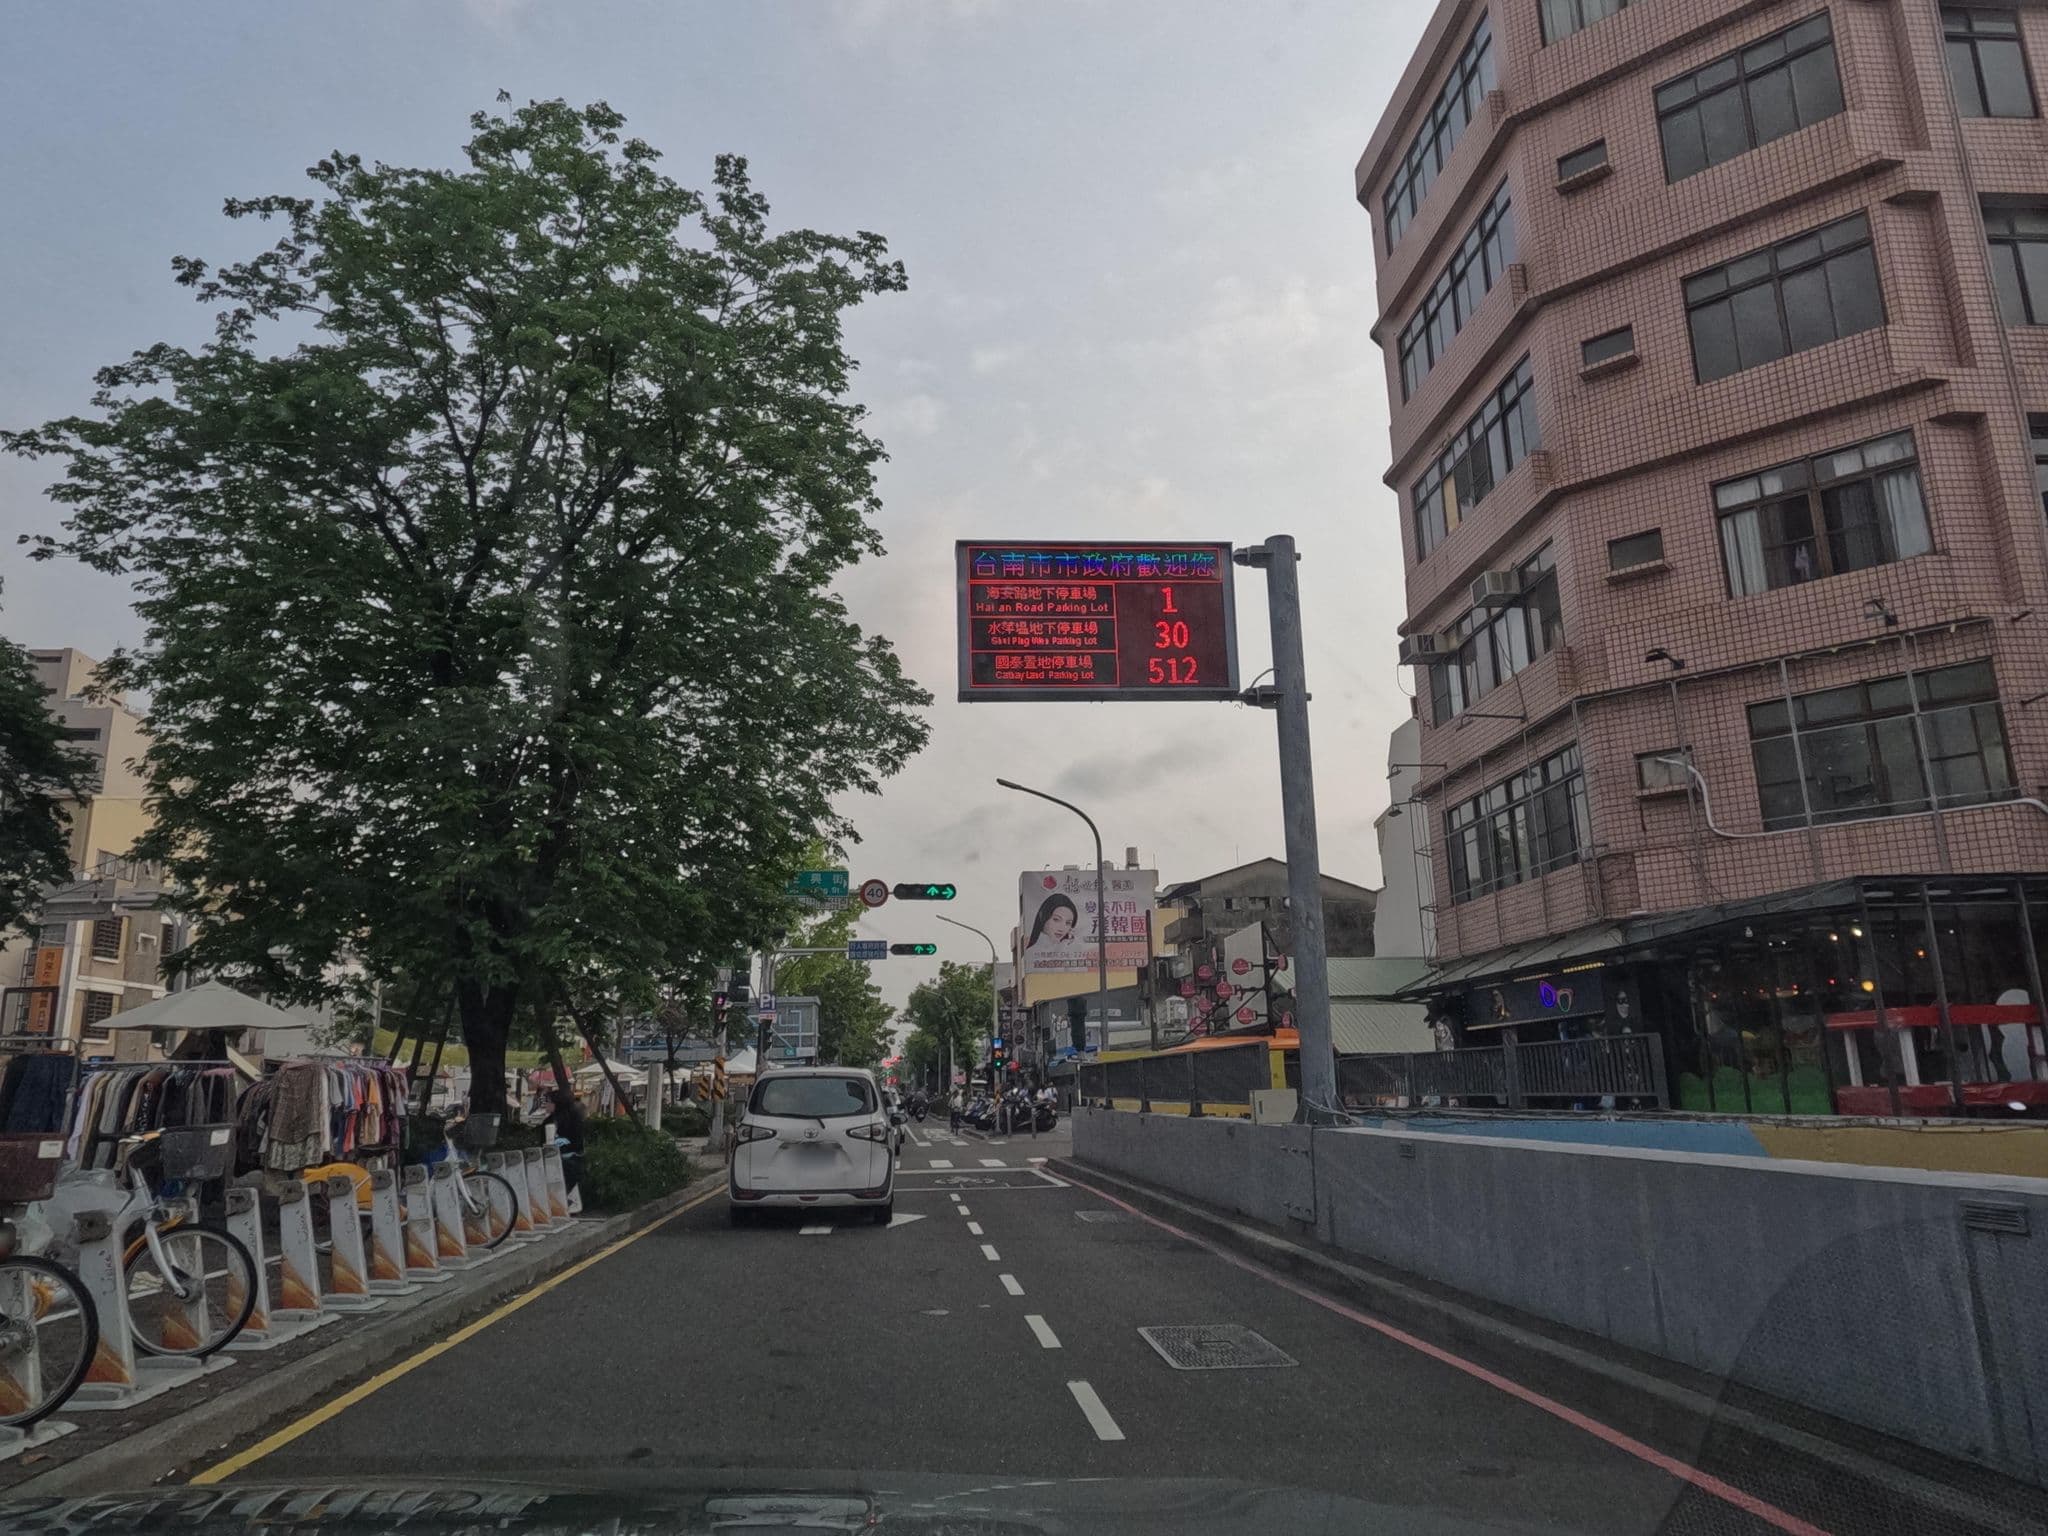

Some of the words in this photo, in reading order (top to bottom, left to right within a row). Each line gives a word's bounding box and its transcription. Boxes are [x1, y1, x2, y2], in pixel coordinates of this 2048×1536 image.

[974, 551, 1216, 577] 台南市市政府歡迎您
[987, 586, 1097, 600] 海安路地下停車場
[1161, 587, 1178, 613] 1
[1015, 603, 1044, 612] Road
[1047, 603, 1087, 614] Parking
[1091, 603, 1109, 612] Lot
[1084, 637, 1098, 645] Lot
[1154, 620, 1189, 648] 30
[995, 655, 1093, 669] 國泰置地停車場
[1048, 671, 1078, 681] Parking
[1081, 671, 1095, 679] Lot
[1148, 656, 1198, 684] 512
[867, 888, 883, 898] 40
